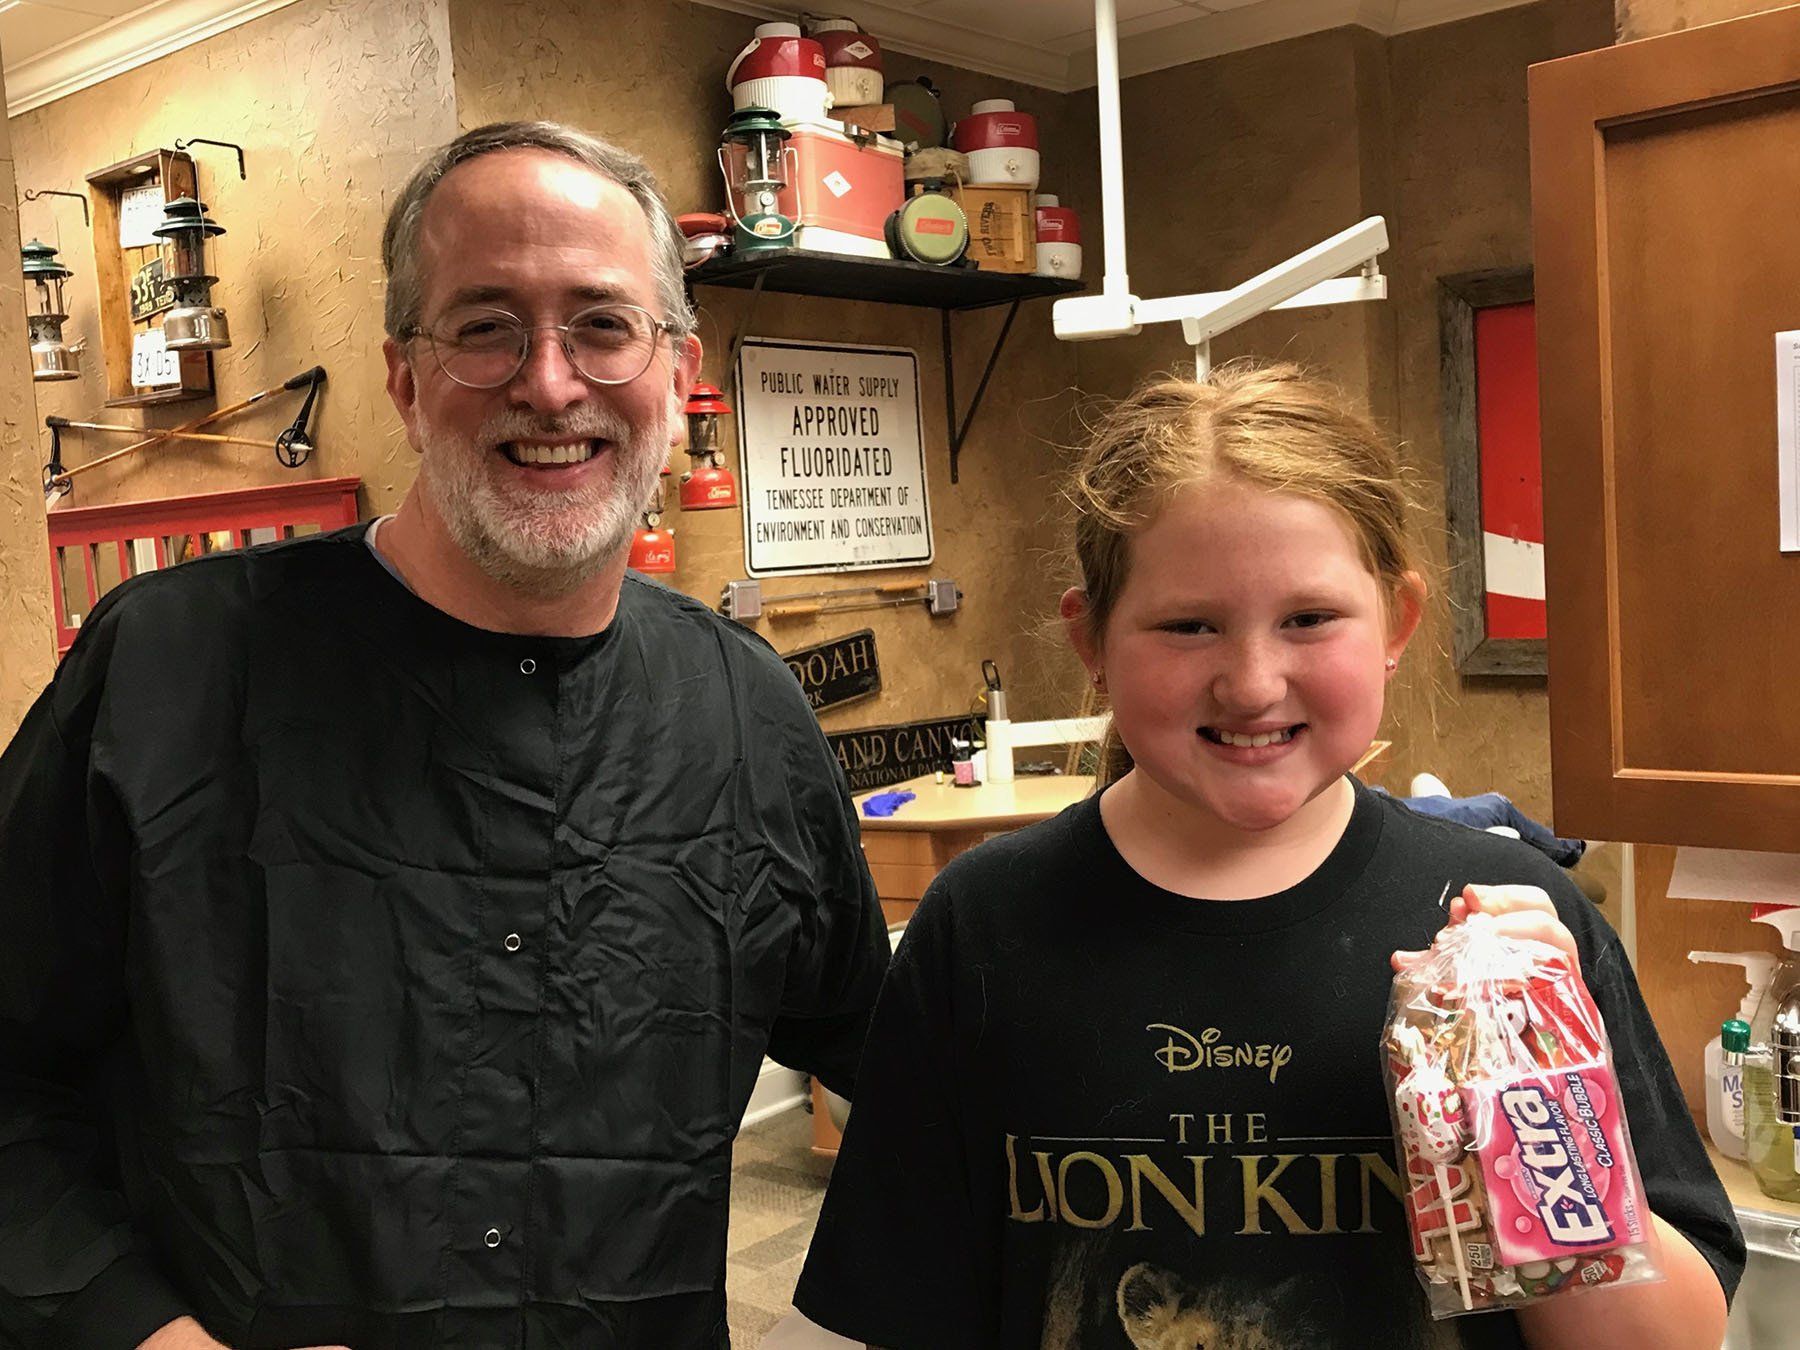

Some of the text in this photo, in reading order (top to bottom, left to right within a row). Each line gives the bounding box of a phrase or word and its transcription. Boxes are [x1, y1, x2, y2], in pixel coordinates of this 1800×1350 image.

[761, 371, 899, 398] PUBLIC WATER SUPPLY
[792, 406, 880, 437] APPROVED
[781, 447, 893, 478] FLUORIDATED
[766, 486, 910, 511] TENNESSEE DEPARTMENT OF
[756, 515, 922, 544] ENVIRONMENT AND CONSERVATION
[849, 764, 912, 788] NATIONAL
[1145, 1023, 1293, 1084] Disney
[1169, 1112, 1269, 1145] THE
[1566, 1073, 1614, 1168] CLASSIC BUBBLE
[1548, 1100, 1597, 1199] LONG LASTING FLAVOR
[1501, 1088, 1612, 1244] Extra
[1005, 1132, 1214, 1238] LION
[1468, 1244, 1480, 1267] 250
